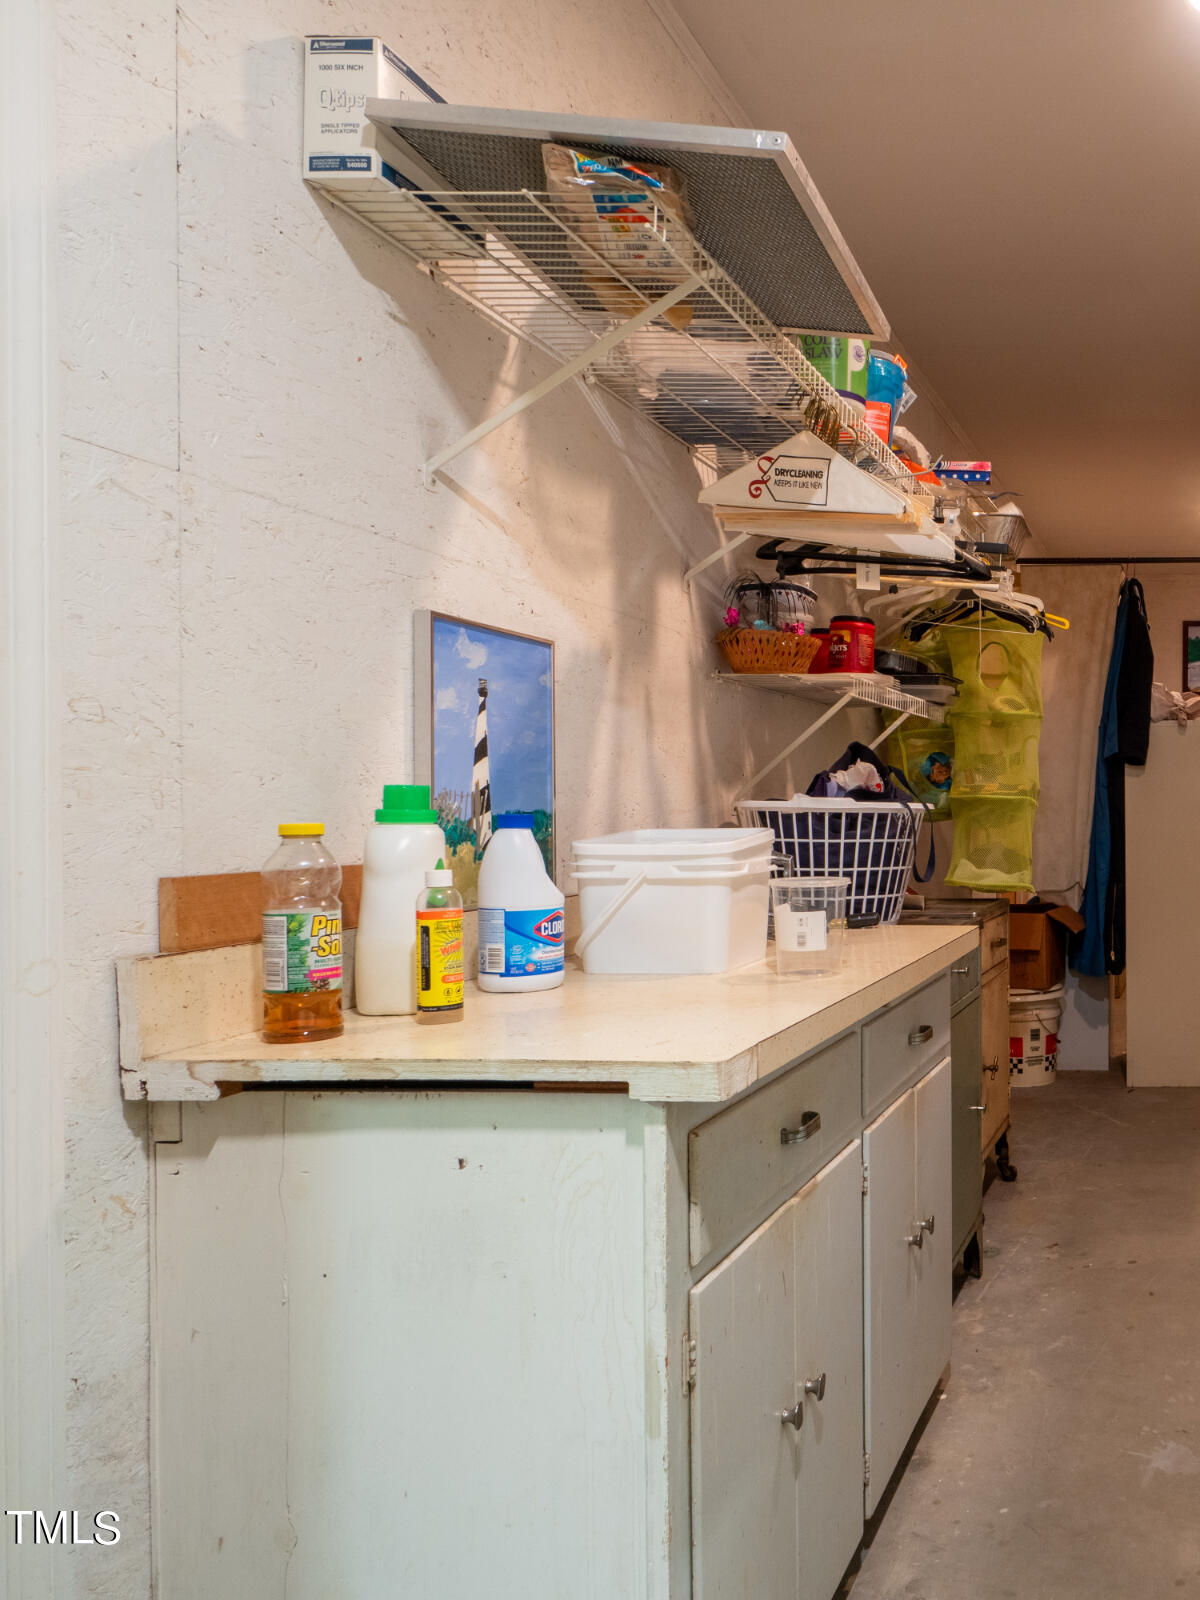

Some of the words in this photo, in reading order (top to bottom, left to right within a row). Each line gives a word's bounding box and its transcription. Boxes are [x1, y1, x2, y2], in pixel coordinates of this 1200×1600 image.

[804, 345, 842, 359] SLAW
[774, 479, 791, 488] KEEPS
[799, 480, 810, 489] LIKE
[311, 914, 341, 937] Pin
[541, 920, 564, 936] CLOR
